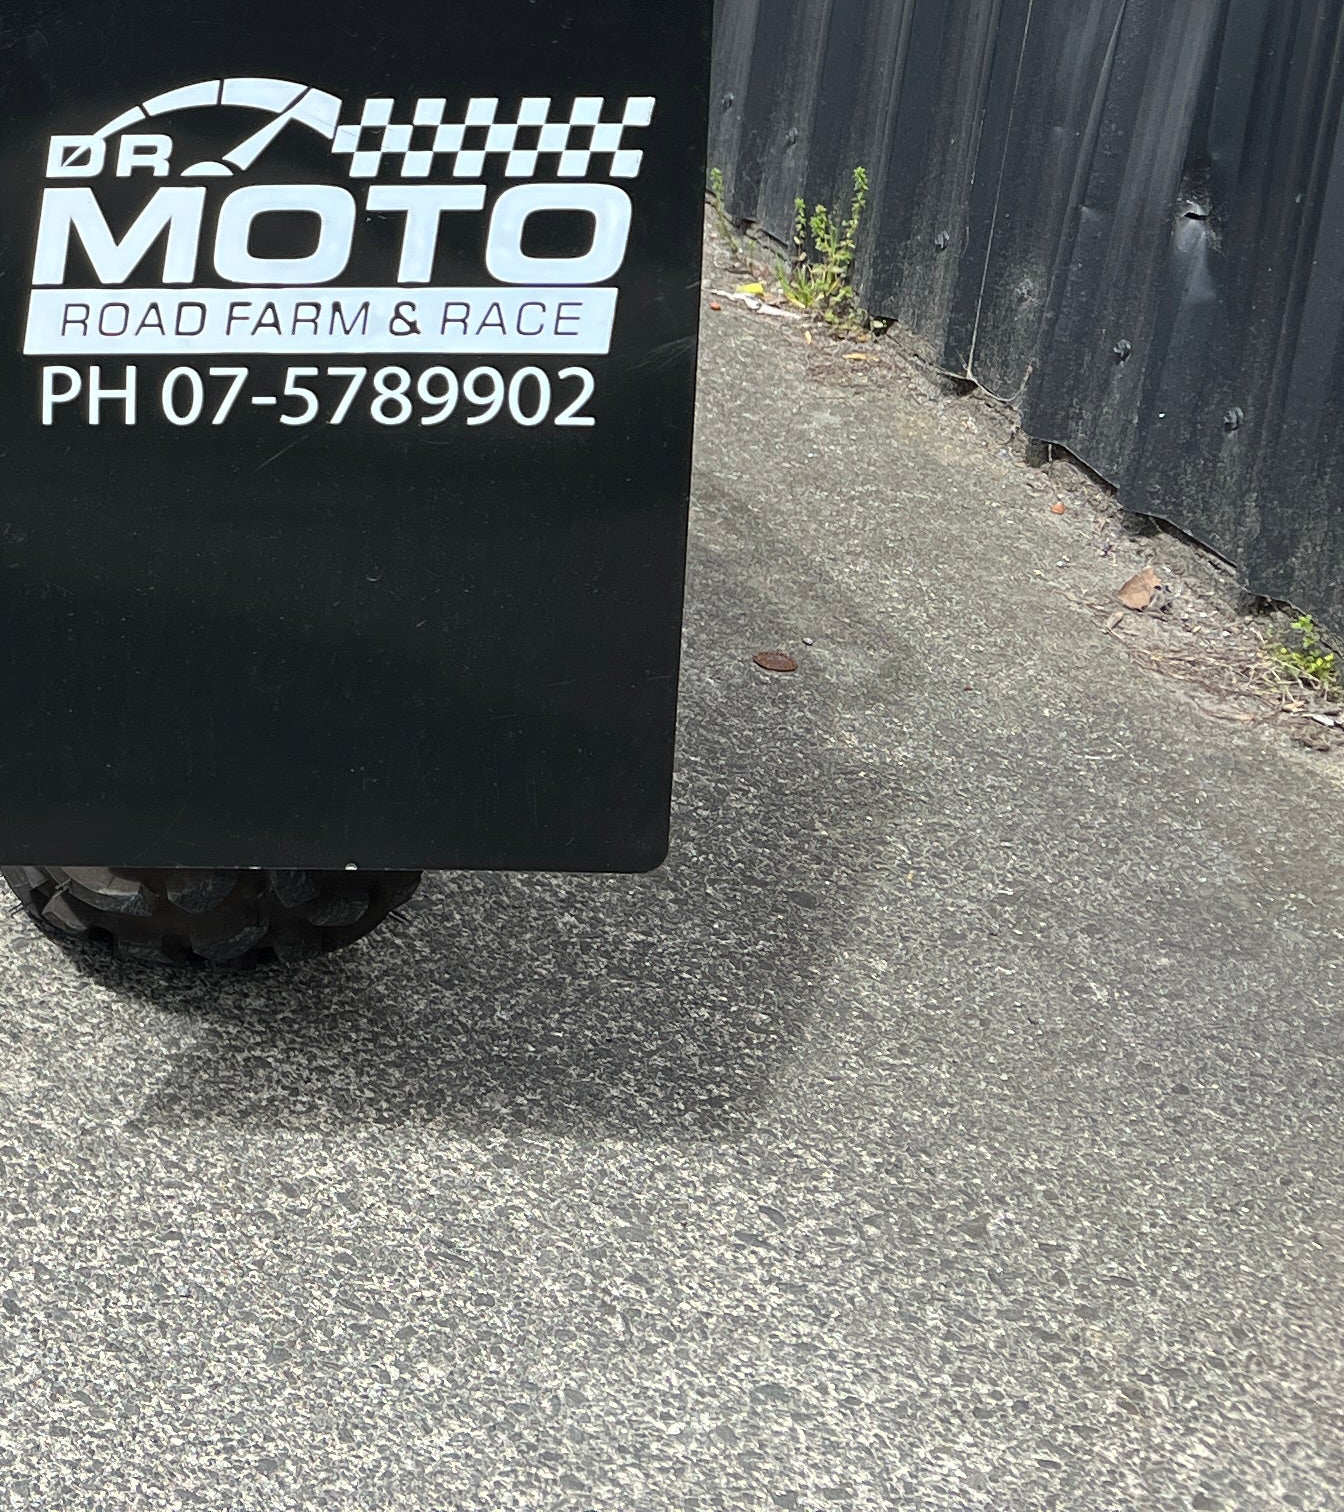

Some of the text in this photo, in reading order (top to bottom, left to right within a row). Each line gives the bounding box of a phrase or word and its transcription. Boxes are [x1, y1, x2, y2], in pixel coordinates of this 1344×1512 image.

[45, 134, 173, 178] DR
[31, 183, 633, 285] MOTO
[61, 301, 583, 337] ROAD FARM & RACE
[42, 365, 596, 426] PH 07-5789902
